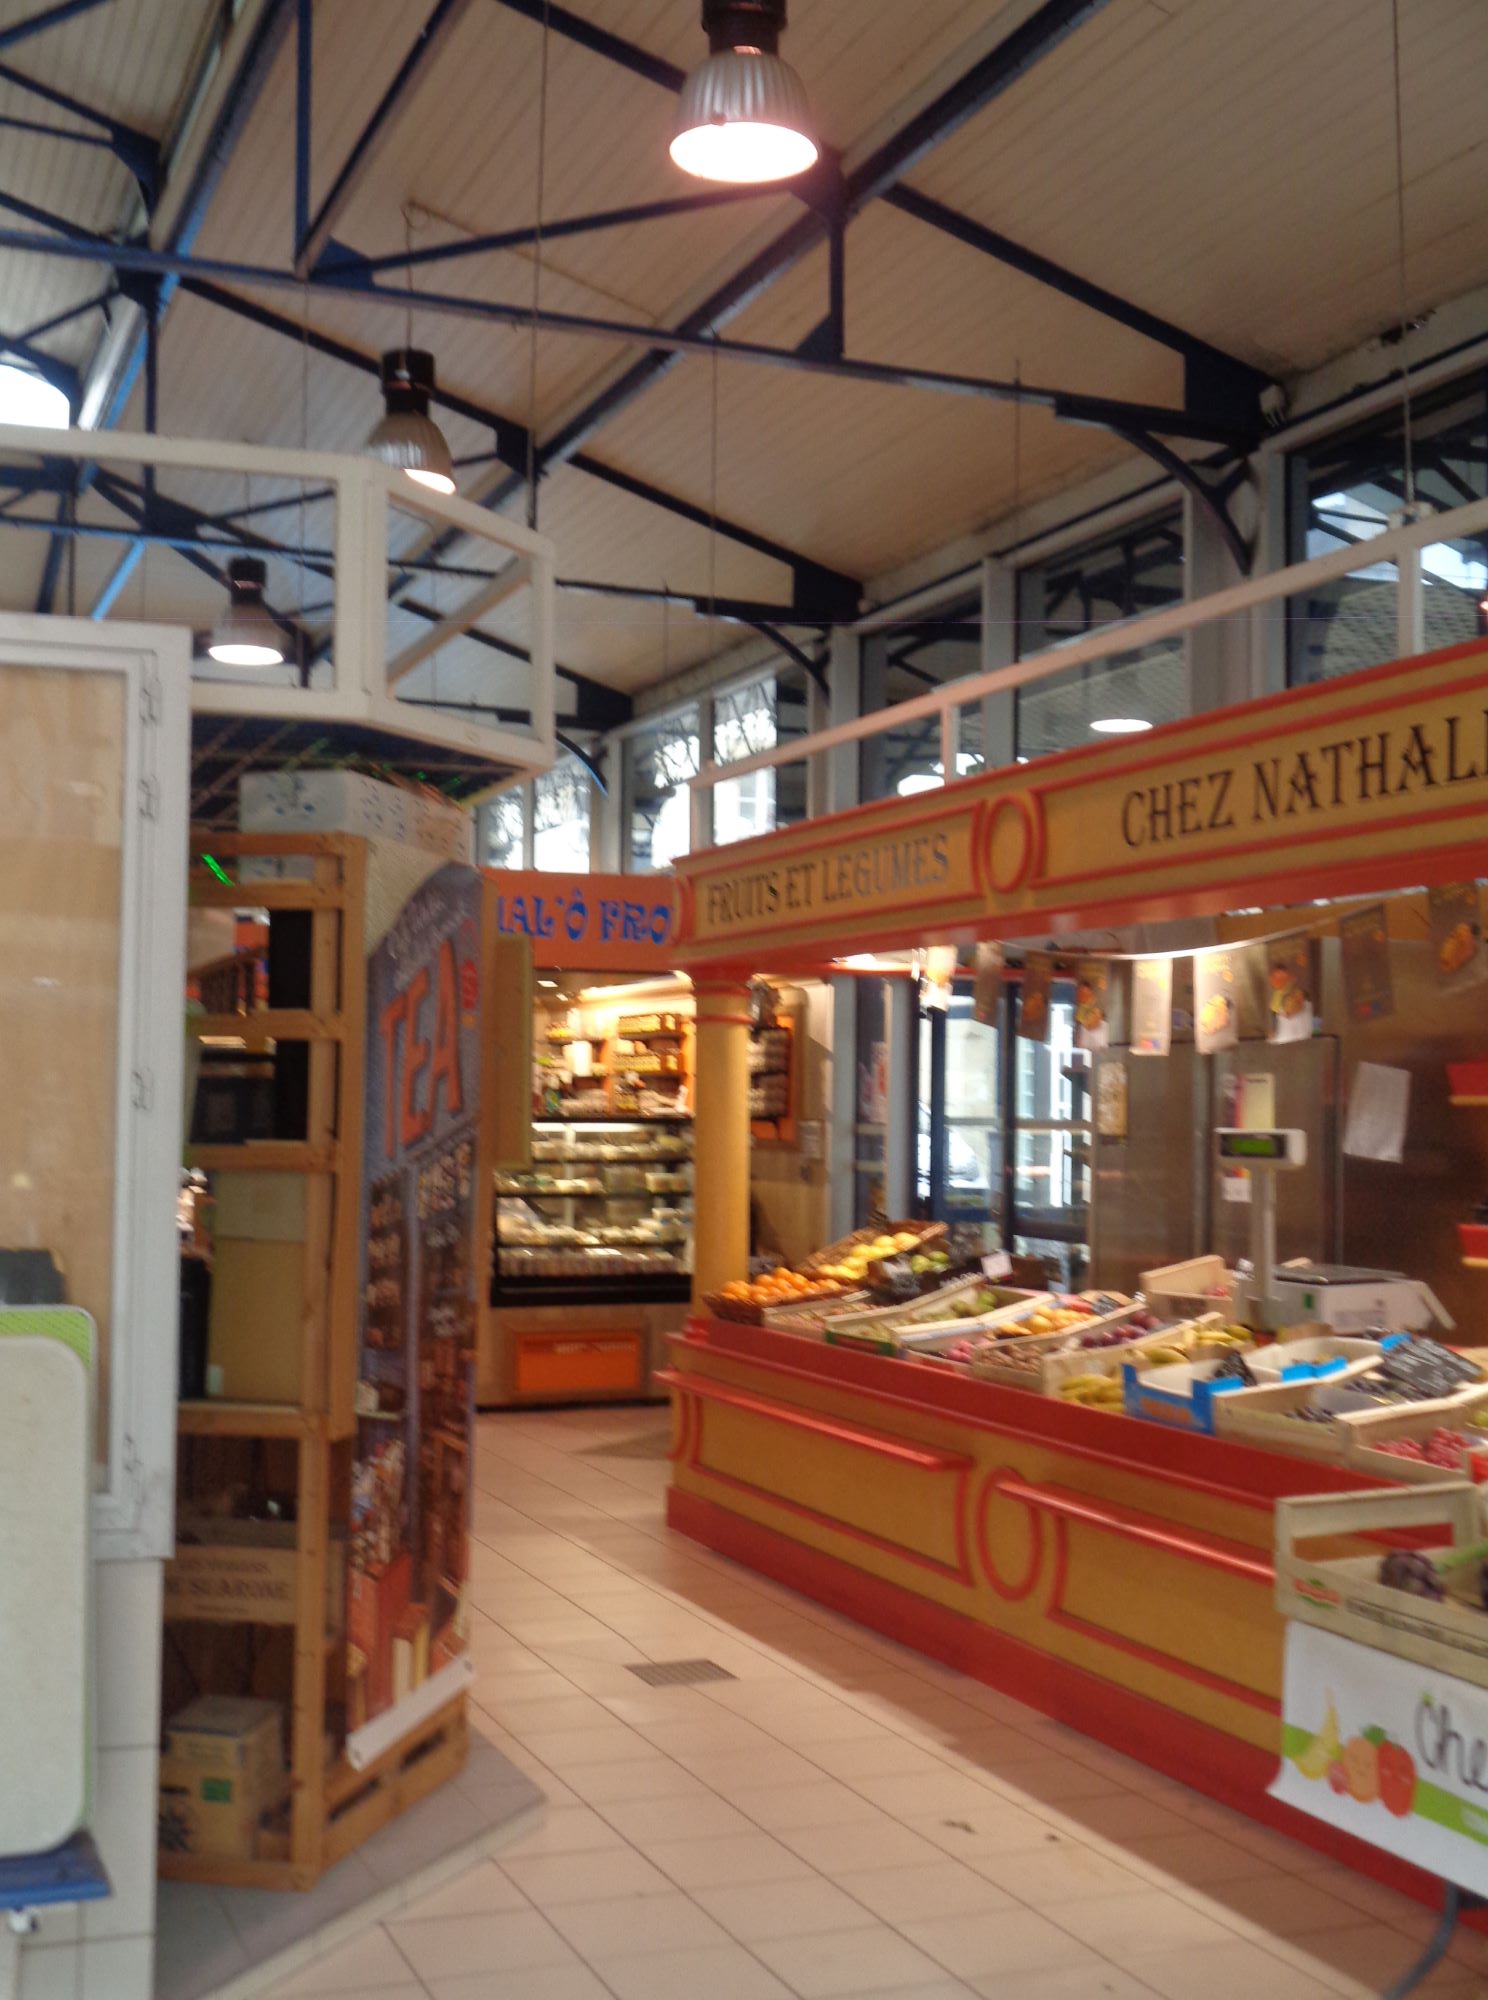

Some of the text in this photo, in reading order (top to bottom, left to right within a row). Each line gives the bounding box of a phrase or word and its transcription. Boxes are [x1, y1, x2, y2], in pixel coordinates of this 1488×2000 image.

[1121, 769, 1234, 848] CHEZ
[706, 832, 949, 926] FRUITS ET LEGUMES
